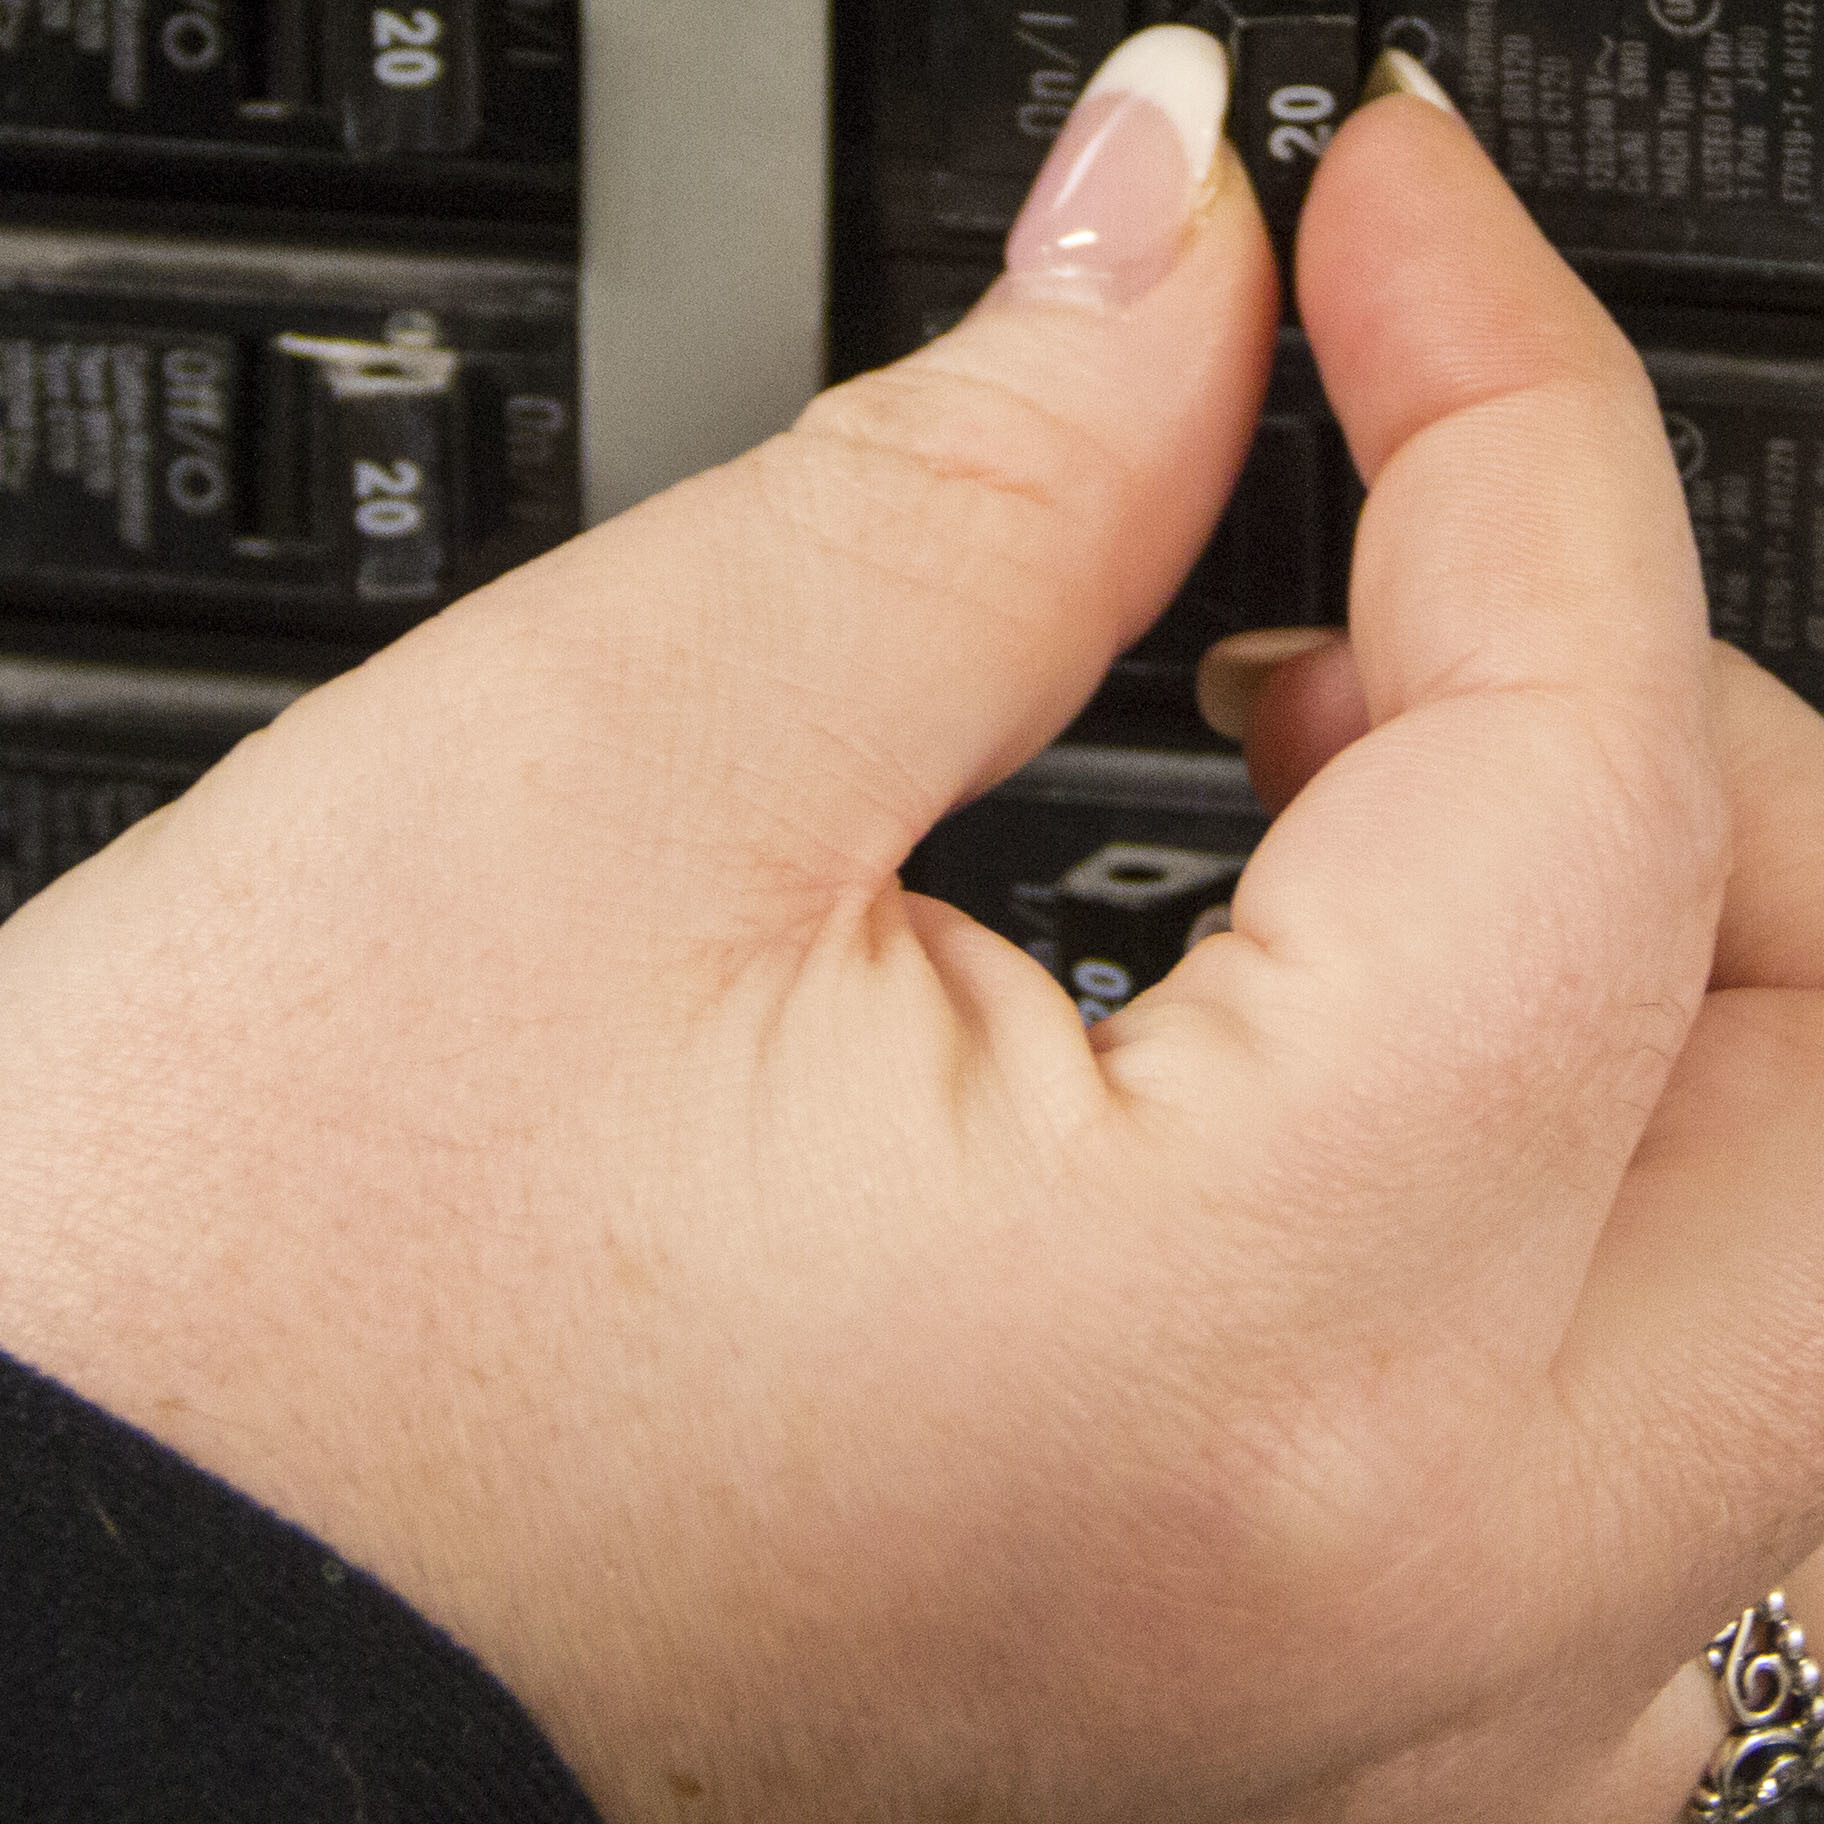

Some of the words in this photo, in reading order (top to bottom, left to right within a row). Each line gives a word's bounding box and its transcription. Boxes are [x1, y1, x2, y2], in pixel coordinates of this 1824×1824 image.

[370, 7, 445, 89] 20
[1266, 83, 1337, 162] 20
[353, 458, 424, 537] 20
